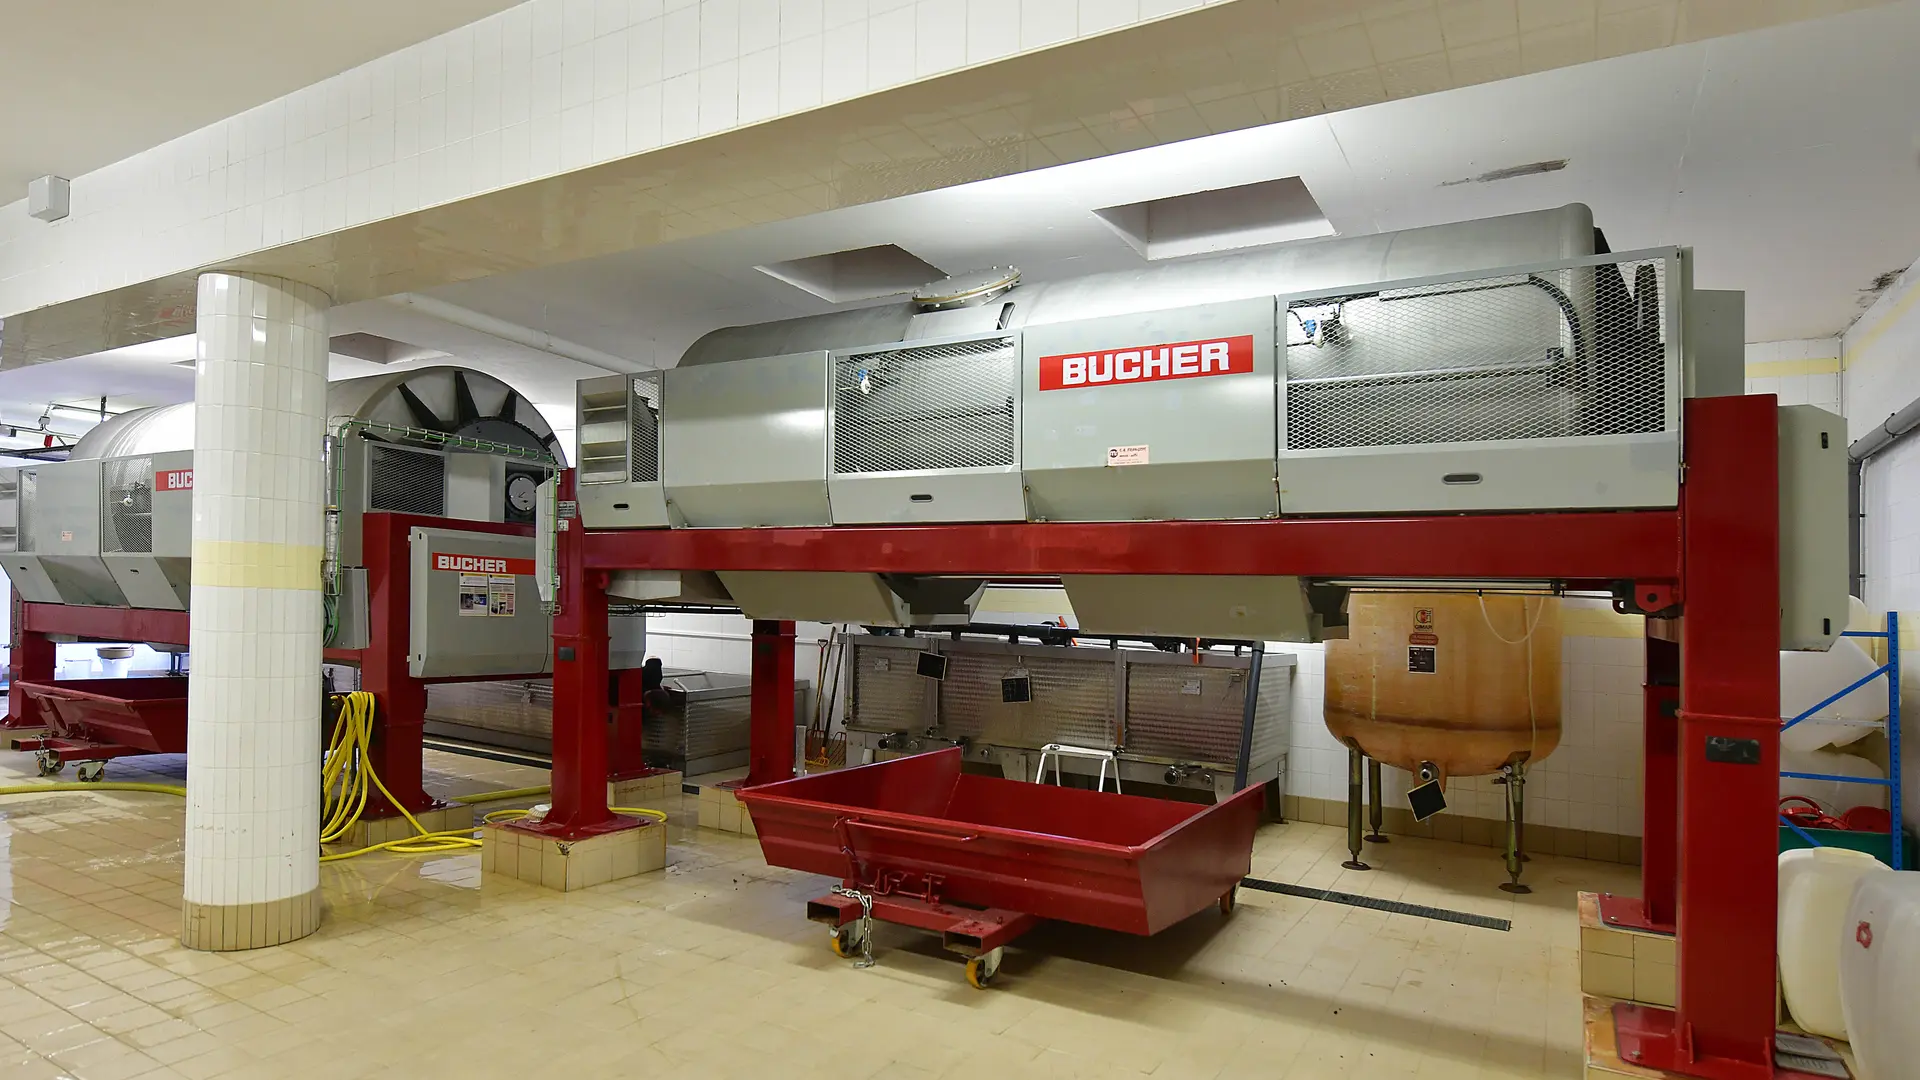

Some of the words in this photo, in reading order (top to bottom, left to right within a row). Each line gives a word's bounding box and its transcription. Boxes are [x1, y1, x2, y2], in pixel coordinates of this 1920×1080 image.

[1062, 341, 1230, 386] BUCHER
[168, 472, 193, 489] BUC
[437, 555, 507, 573] BUCHER
